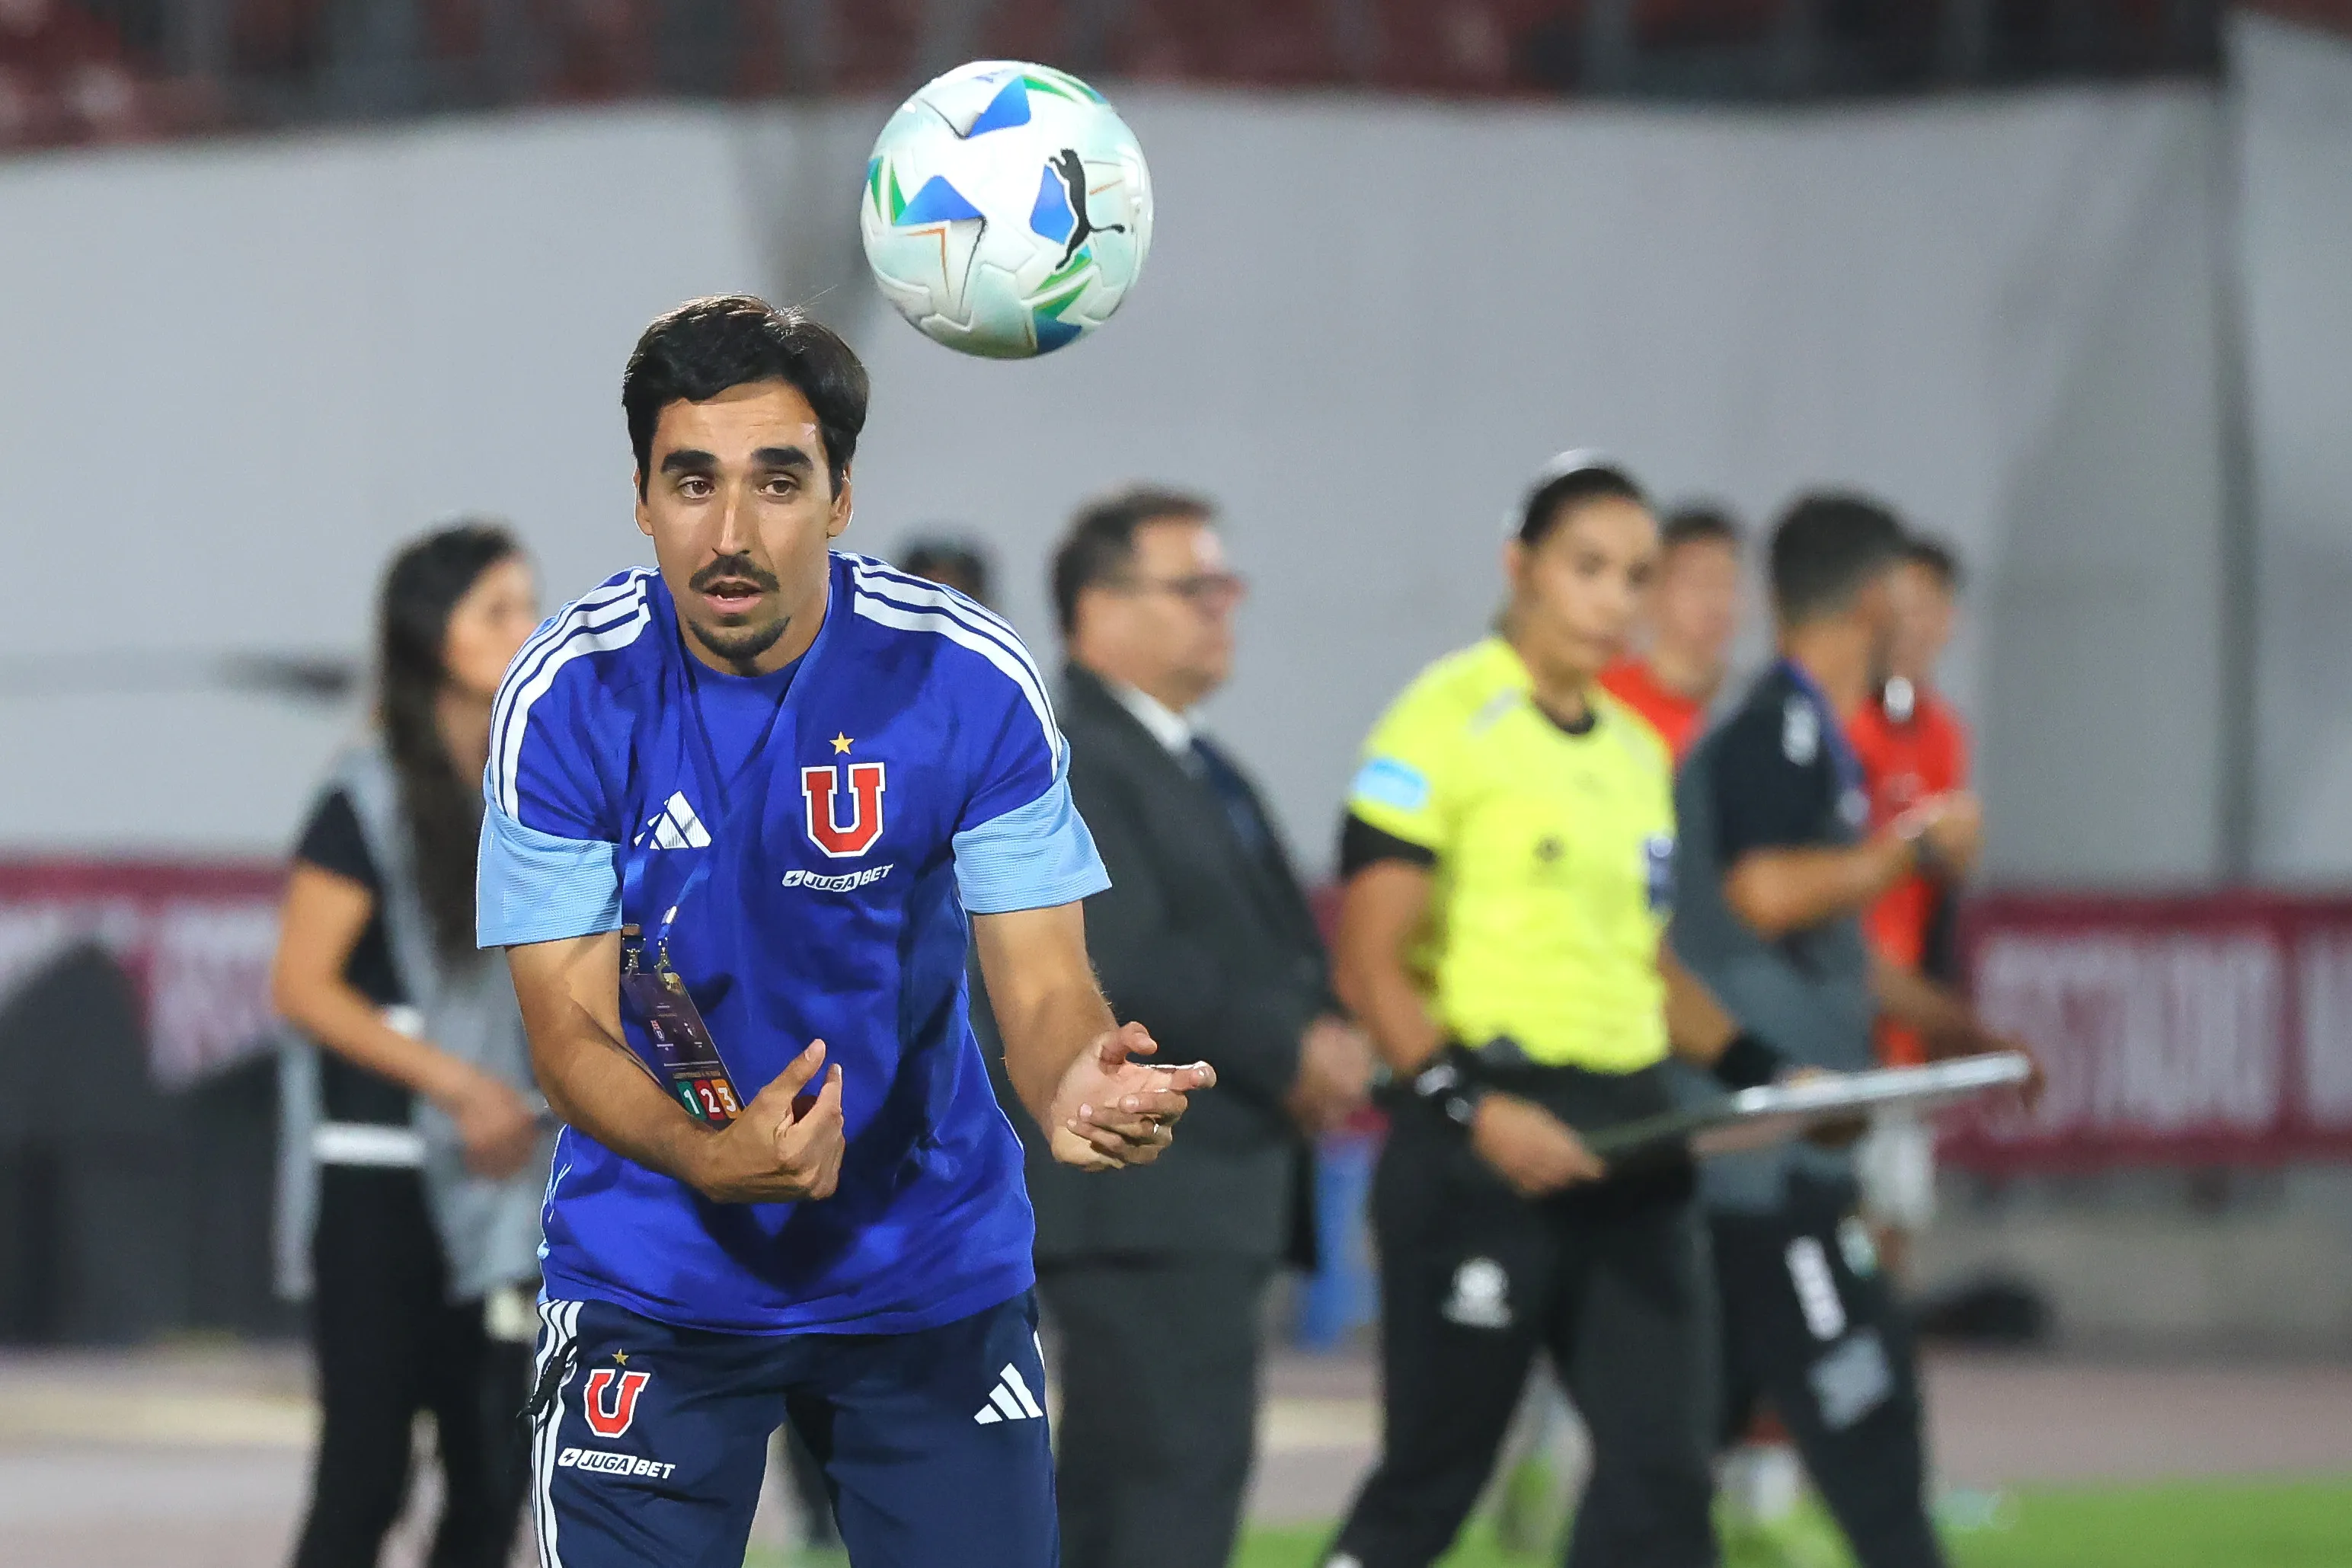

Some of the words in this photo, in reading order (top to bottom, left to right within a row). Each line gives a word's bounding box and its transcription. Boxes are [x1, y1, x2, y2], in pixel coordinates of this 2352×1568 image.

[801, 762, 885, 858] U
[804, 864, 894, 892] JUGABET
[584, 1368, 651, 1439] U
[578, 1451, 676, 1479] JUGABET
